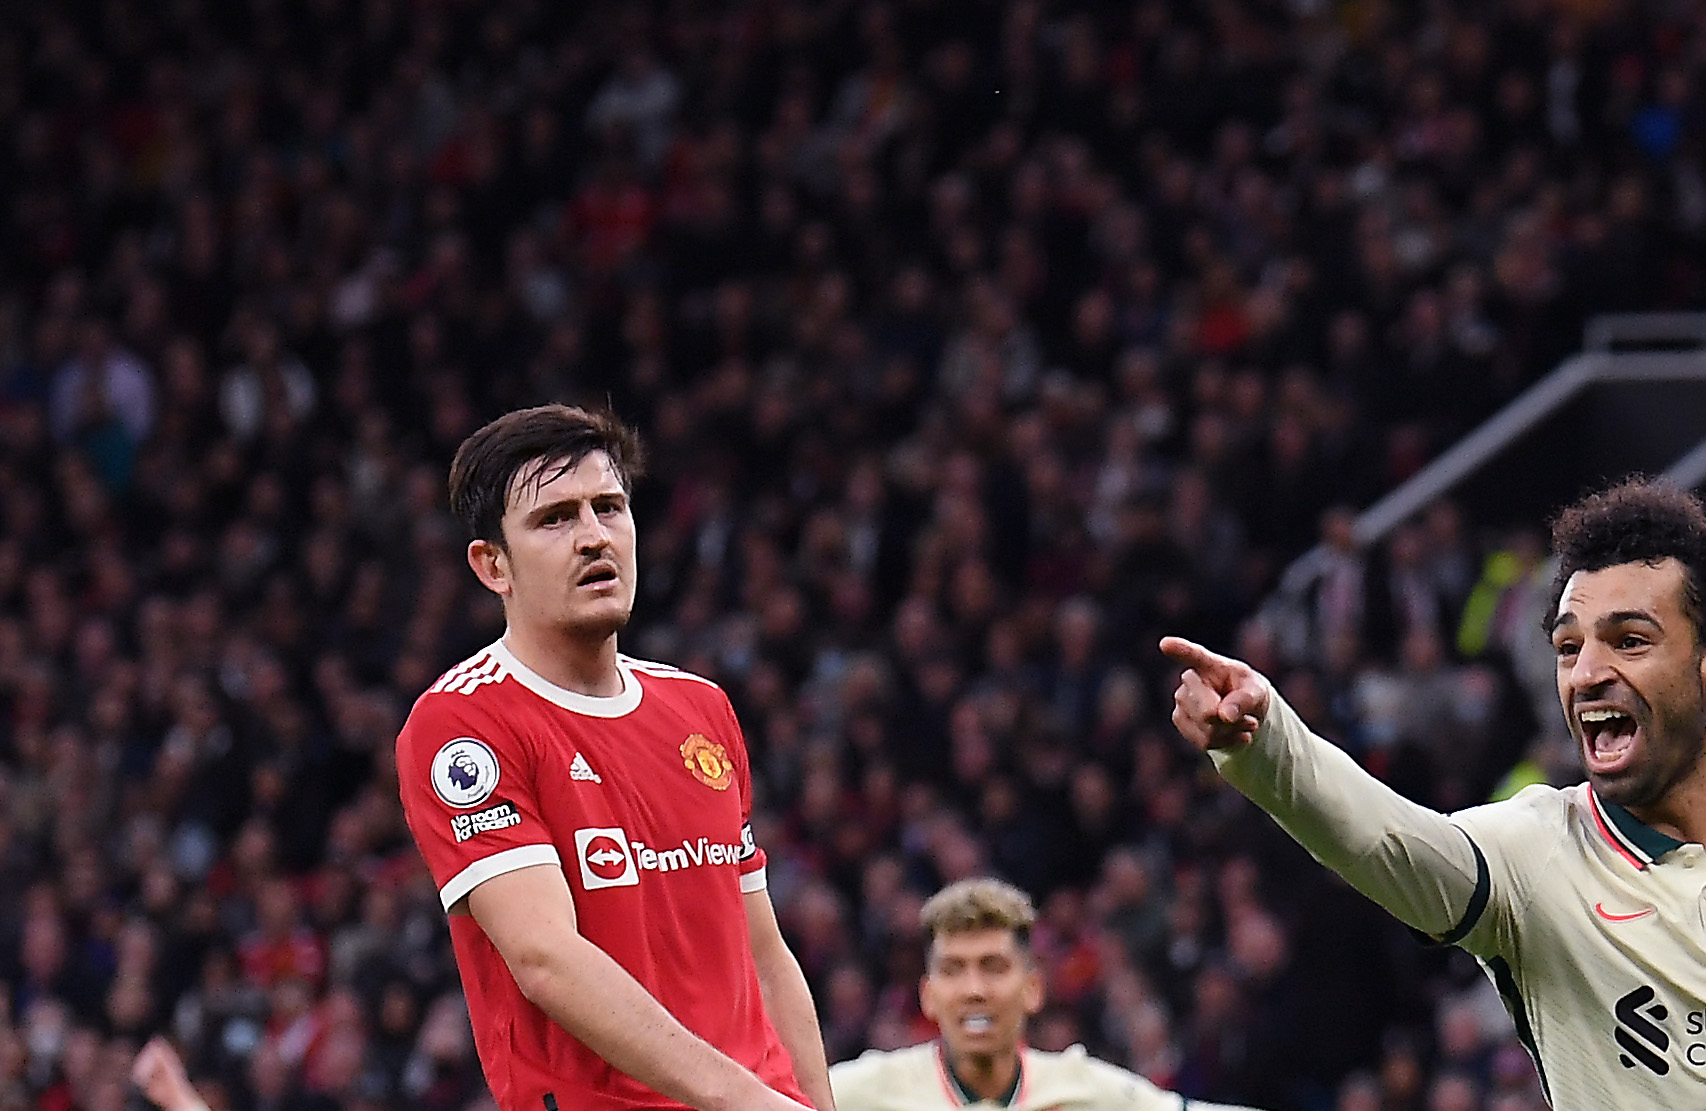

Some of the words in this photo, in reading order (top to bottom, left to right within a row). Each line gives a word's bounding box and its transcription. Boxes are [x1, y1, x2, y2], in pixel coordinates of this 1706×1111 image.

[450, 814, 470, 829] No
[470, 804, 511, 822] room
[453, 823, 473, 842] for
[472, 813, 521, 834] racism
